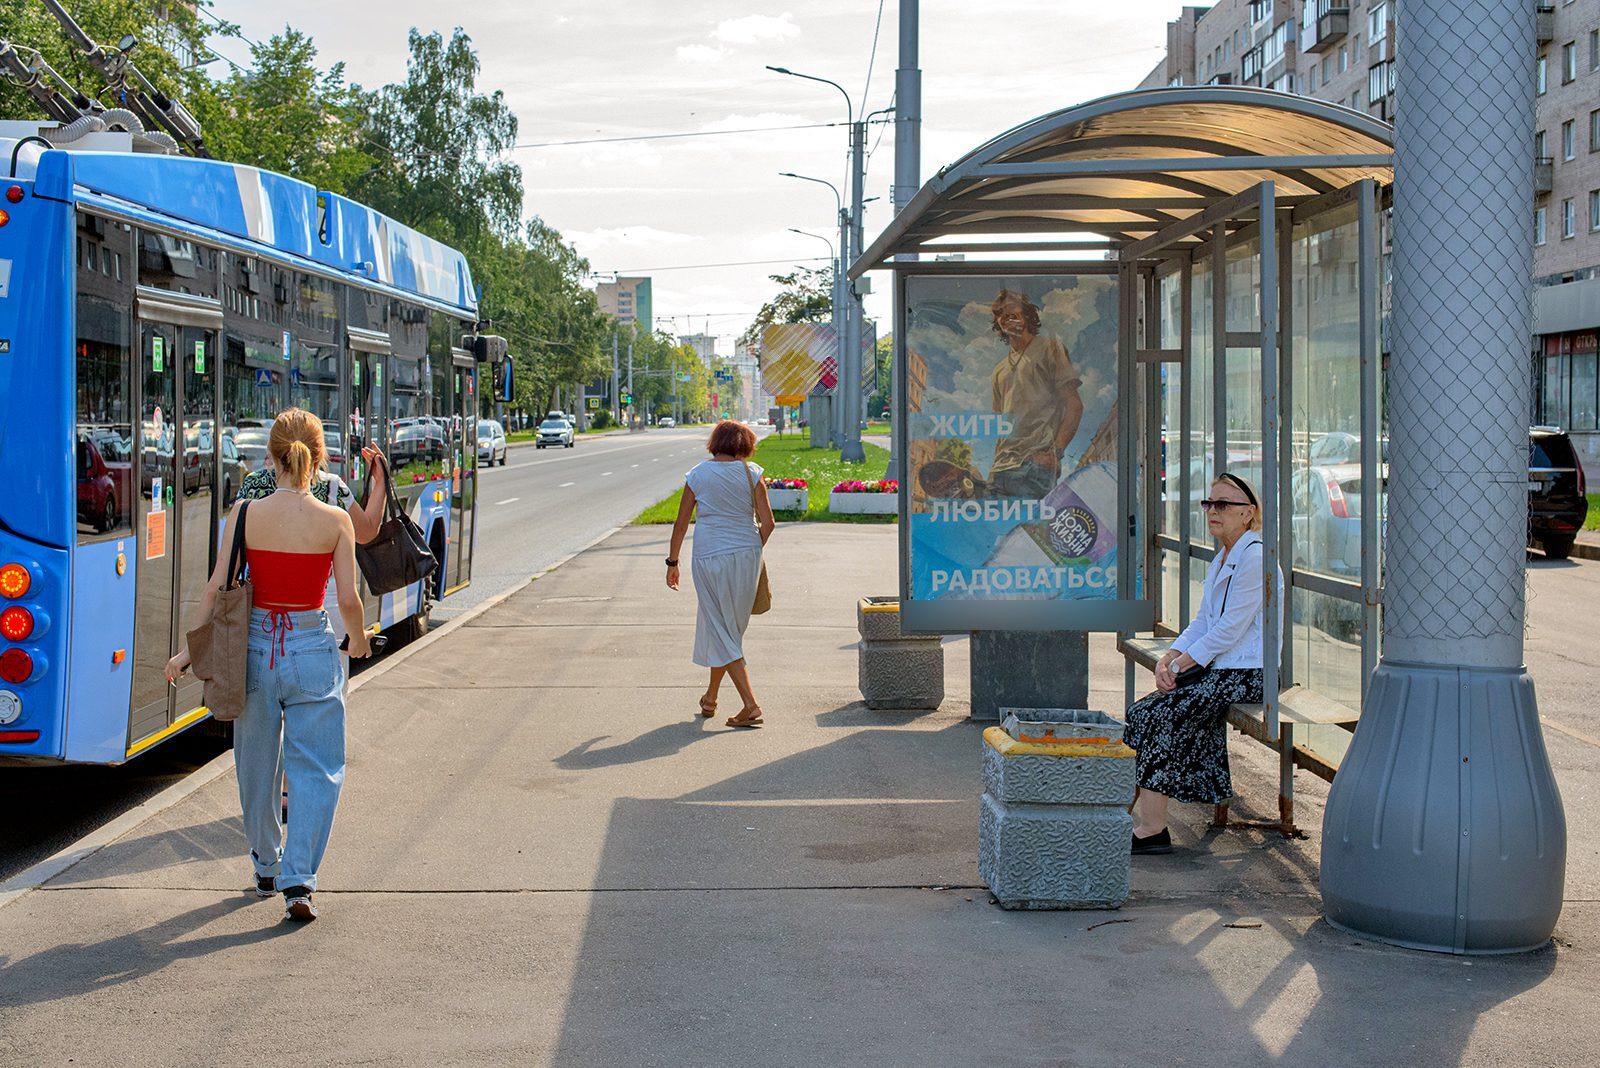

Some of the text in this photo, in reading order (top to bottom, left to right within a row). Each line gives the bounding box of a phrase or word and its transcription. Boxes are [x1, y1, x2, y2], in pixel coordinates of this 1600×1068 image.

[929, 414, 1014, 436] ЖИТЬ
[929, 499, 1057, 522] ЛЮБИТЬ
[1049, 517, 1086, 556] ЖИЗНИ
[1058, 508, 1093, 548] НОРМА
[931, 566, 1118, 594] РАДОВАТЬСЯ
